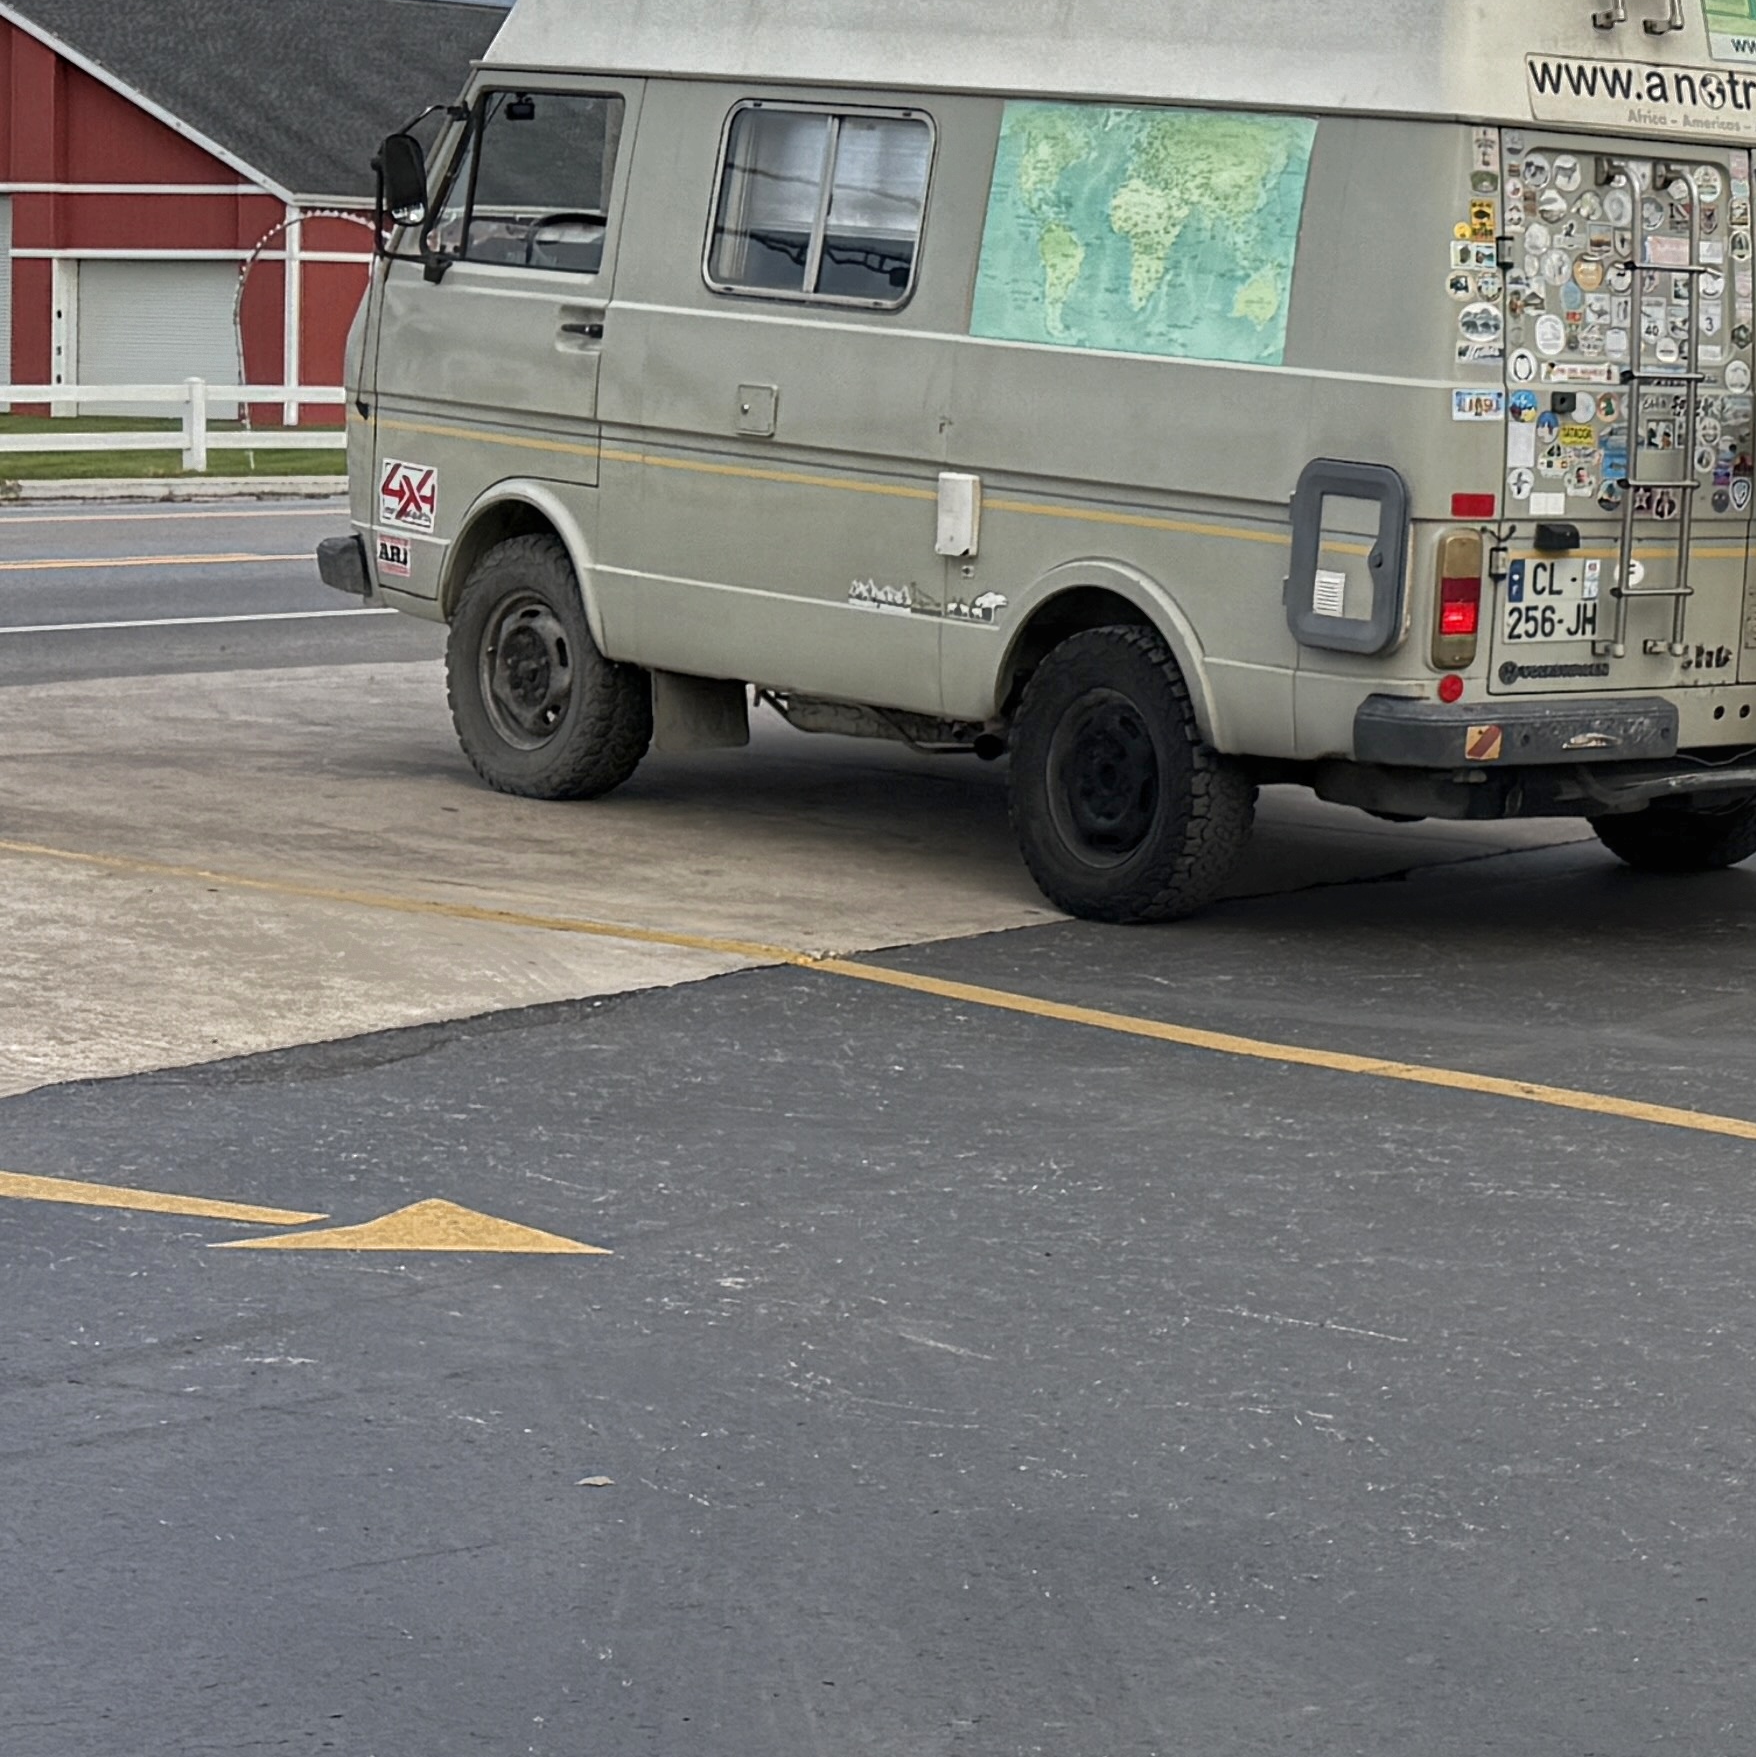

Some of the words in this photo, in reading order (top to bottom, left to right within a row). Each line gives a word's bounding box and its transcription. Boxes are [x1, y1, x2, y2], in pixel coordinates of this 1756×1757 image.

[1627, 109, 1667, 126] Africa
[1683, 114, 1741, 132] Americas
[1507, 603, 1597, 640] 256-JH
